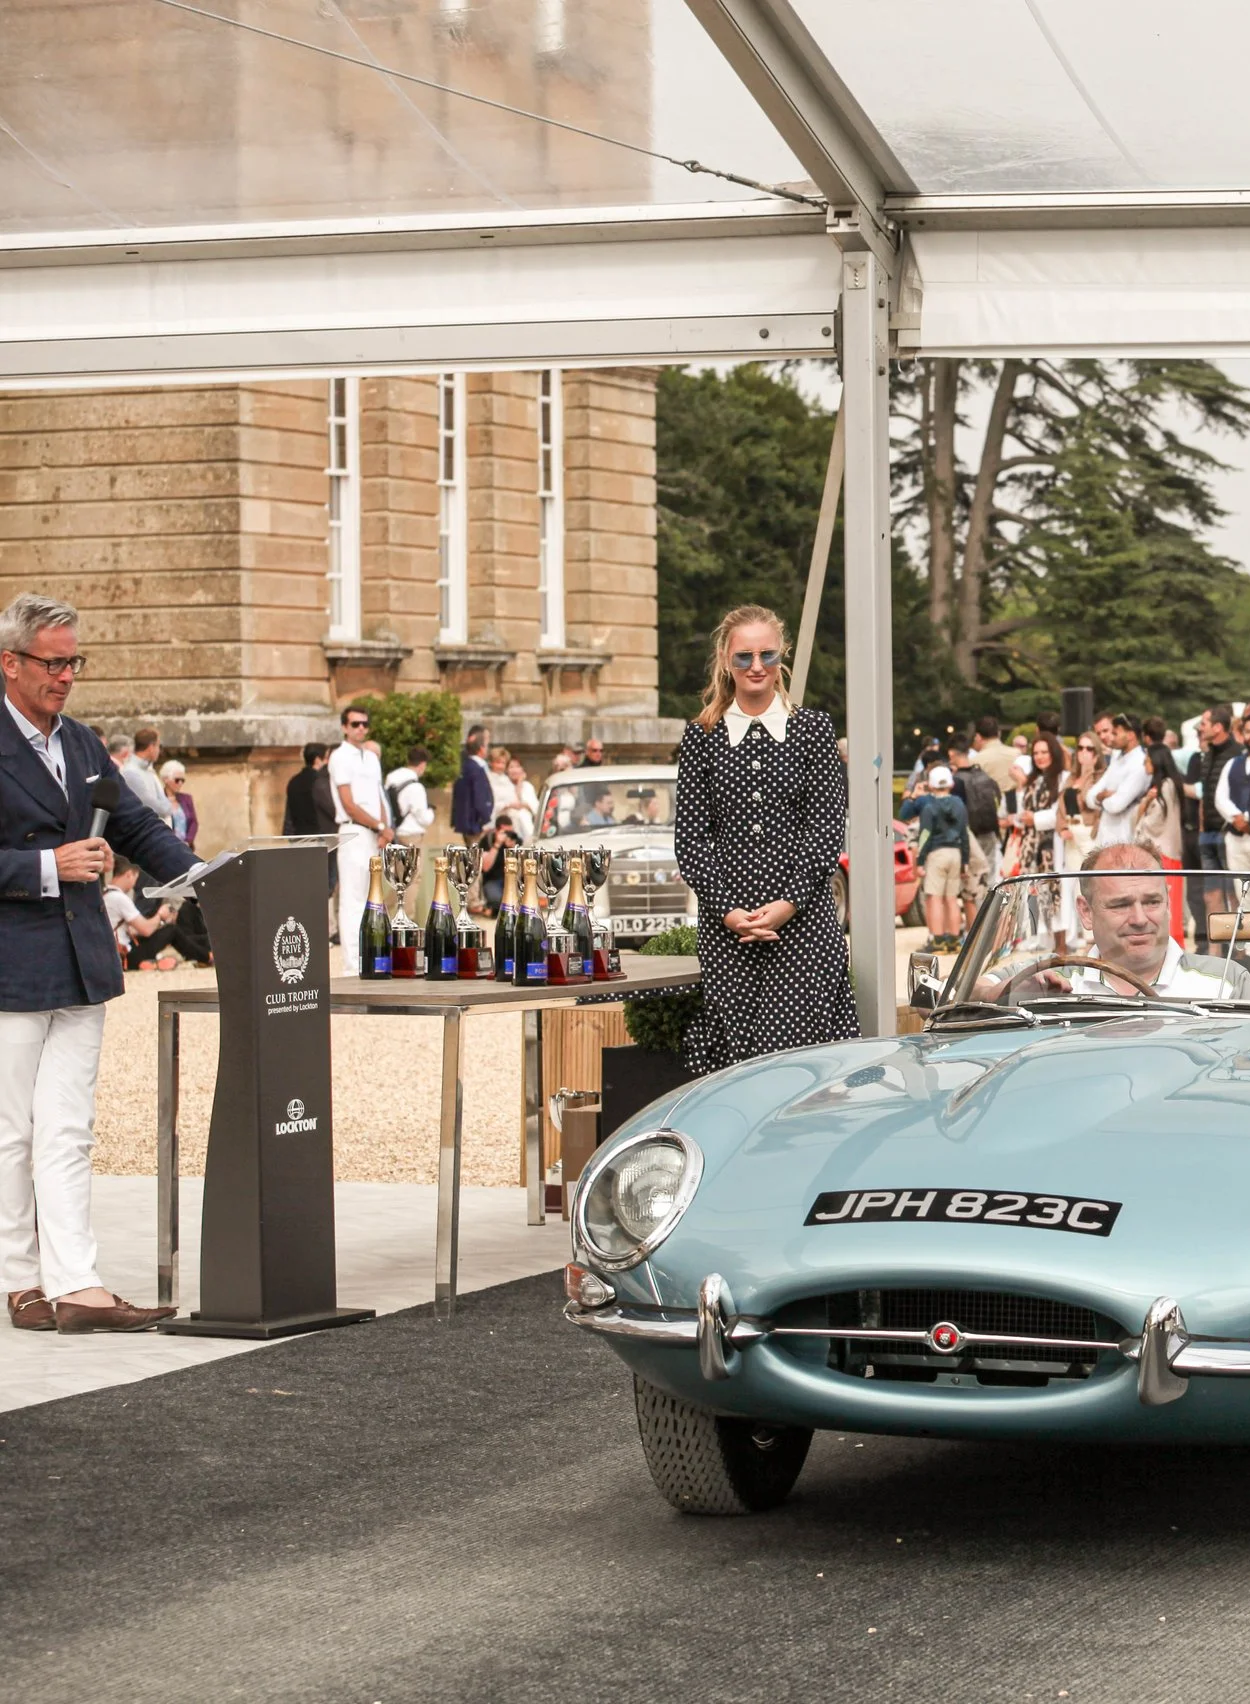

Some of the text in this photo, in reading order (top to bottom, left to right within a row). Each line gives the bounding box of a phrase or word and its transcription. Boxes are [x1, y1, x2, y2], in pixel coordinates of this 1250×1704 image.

[613, 918, 643, 932] DLO
[281, 934, 301, 946] SALON
[265, 989, 319, 1005] CLUB TROPHY
[268, 1002, 318, 1016] presented by Lockton
[275, 1118, 317, 1136] LOCKTON
[815, 1191, 1110, 1231] JPH 823C
